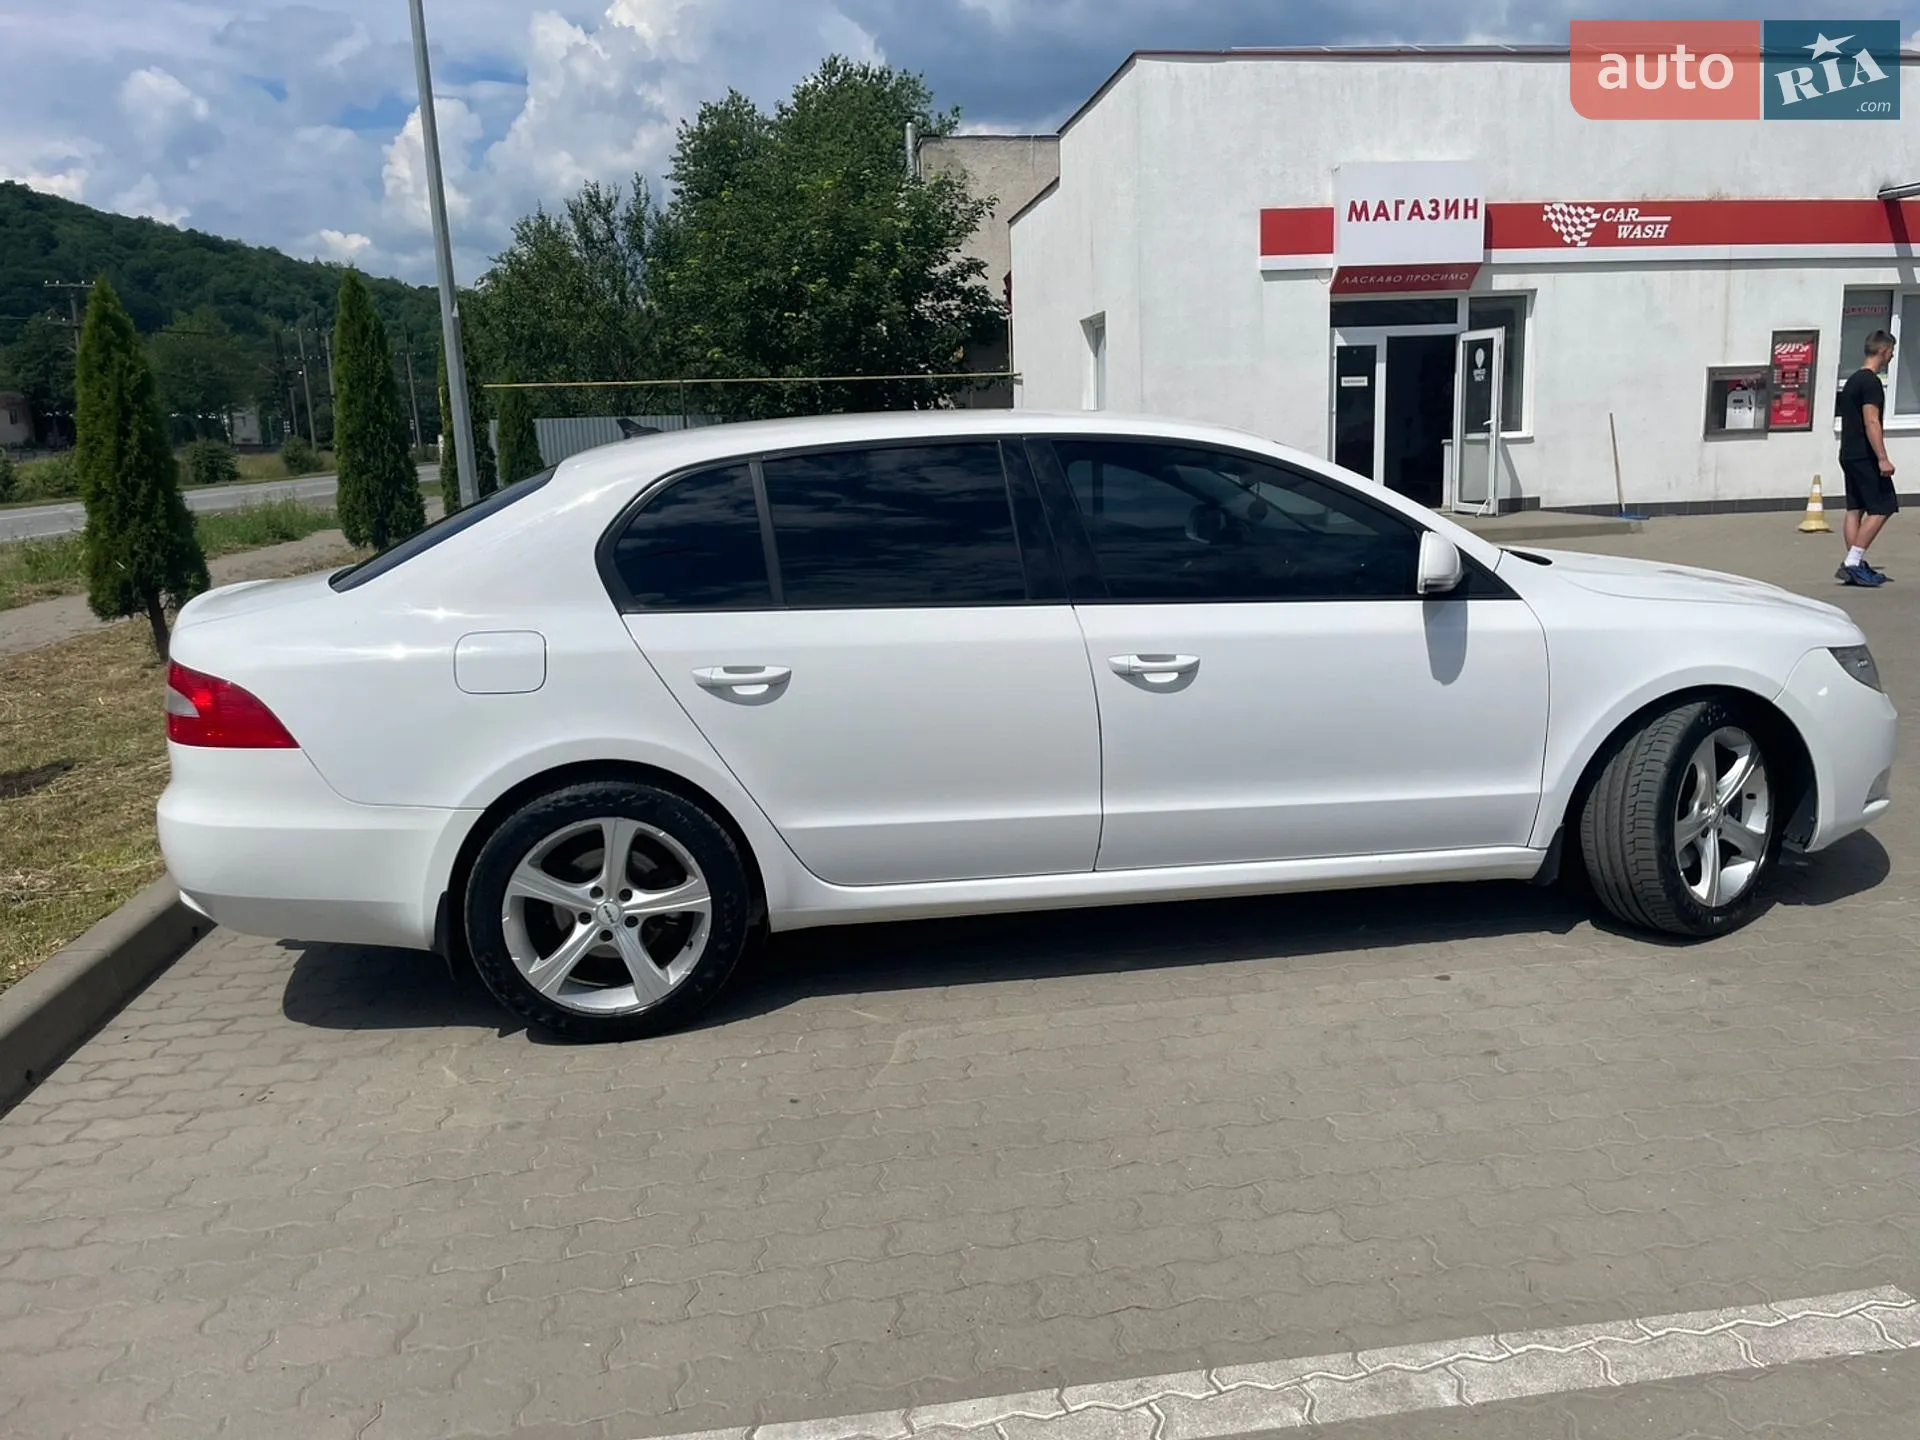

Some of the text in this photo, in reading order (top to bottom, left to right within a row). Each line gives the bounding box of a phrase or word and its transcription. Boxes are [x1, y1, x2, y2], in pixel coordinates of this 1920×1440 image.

[1347, 198, 1479, 223] МАГАЗИН
[1602, 207, 1640, 222] CAR
[1617, 224, 1669, 239] WASH
[1341, 271, 1470, 285] ЛАСКАВО ПРОСИМО
